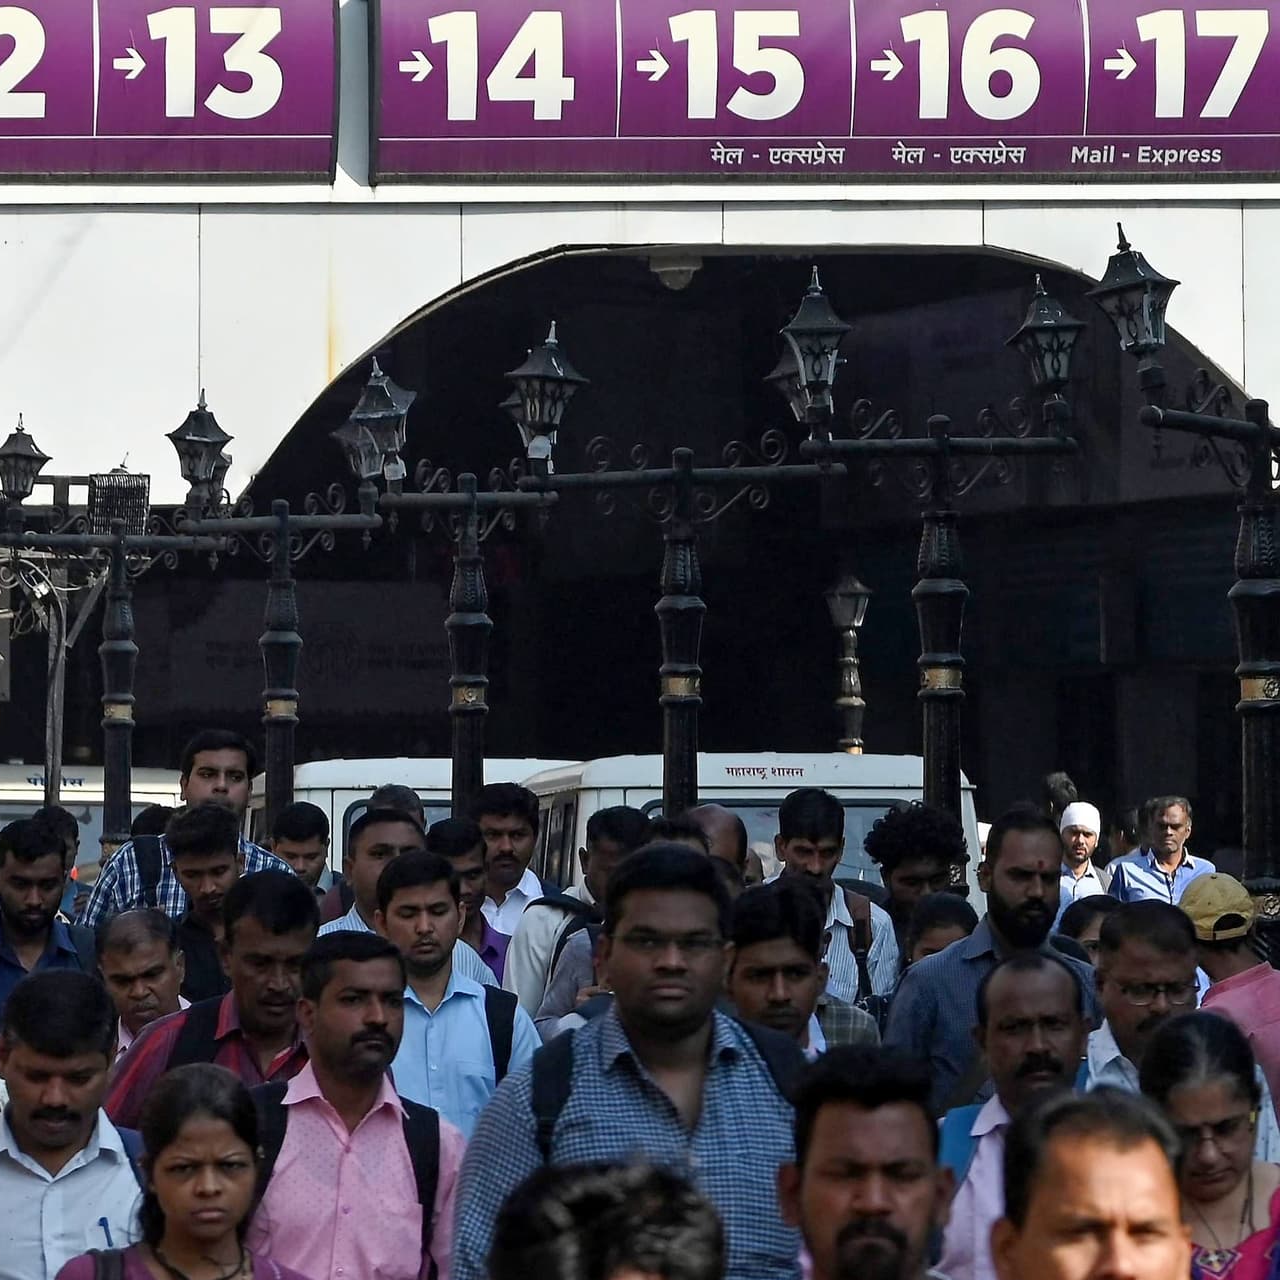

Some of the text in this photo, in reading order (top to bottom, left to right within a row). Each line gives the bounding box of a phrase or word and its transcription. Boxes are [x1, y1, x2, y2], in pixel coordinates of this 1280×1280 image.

[147, 7, 282, 119] 13
[428, 11, 574, 120] 14
[669, 10, 804, 120] 15
[900, 9, 1040, 120] 16
[1136, 10, 1269, 117] 17
[711, 143, 744, 164] मेल
[769, 143, 845, 165] एक्सप्रेस
[892, 143, 925, 164] मेल
[950, 143, 1026, 165] एक्सप्रेस
[1072, 146, 1115, 163] Mail
[1138, 146, 1222, 167] Express
[726, 767, 804, 780] महाराष्ट्र शासन
